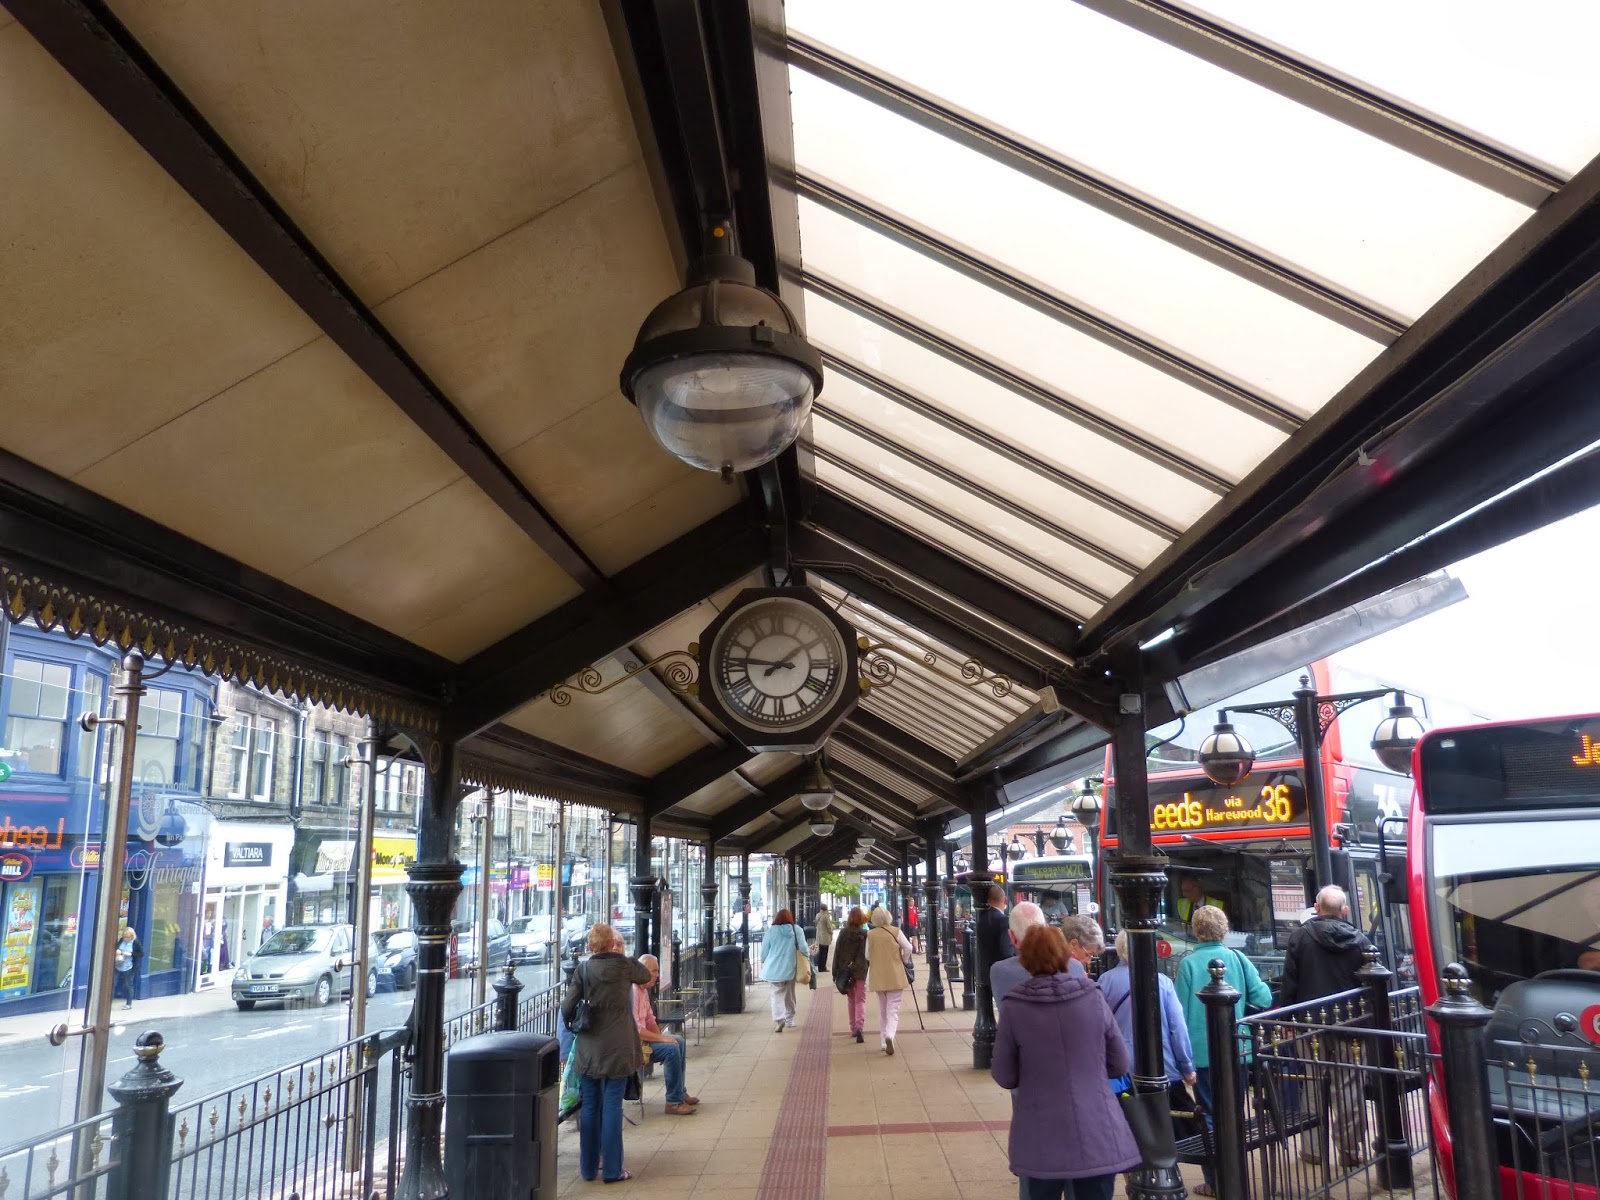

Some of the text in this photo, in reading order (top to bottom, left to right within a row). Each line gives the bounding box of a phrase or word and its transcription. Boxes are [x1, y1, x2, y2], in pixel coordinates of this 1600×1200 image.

[1150, 784, 1290, 829] eeds Harewood 36
[1224, 796, 1243, 808] via
[232, 847, 263, 859] VALTIARA
[2, 865, 21, 876] HILL
[1090, 904, 1096, 912] 9
[1160, 943, 1167, 954] 7
